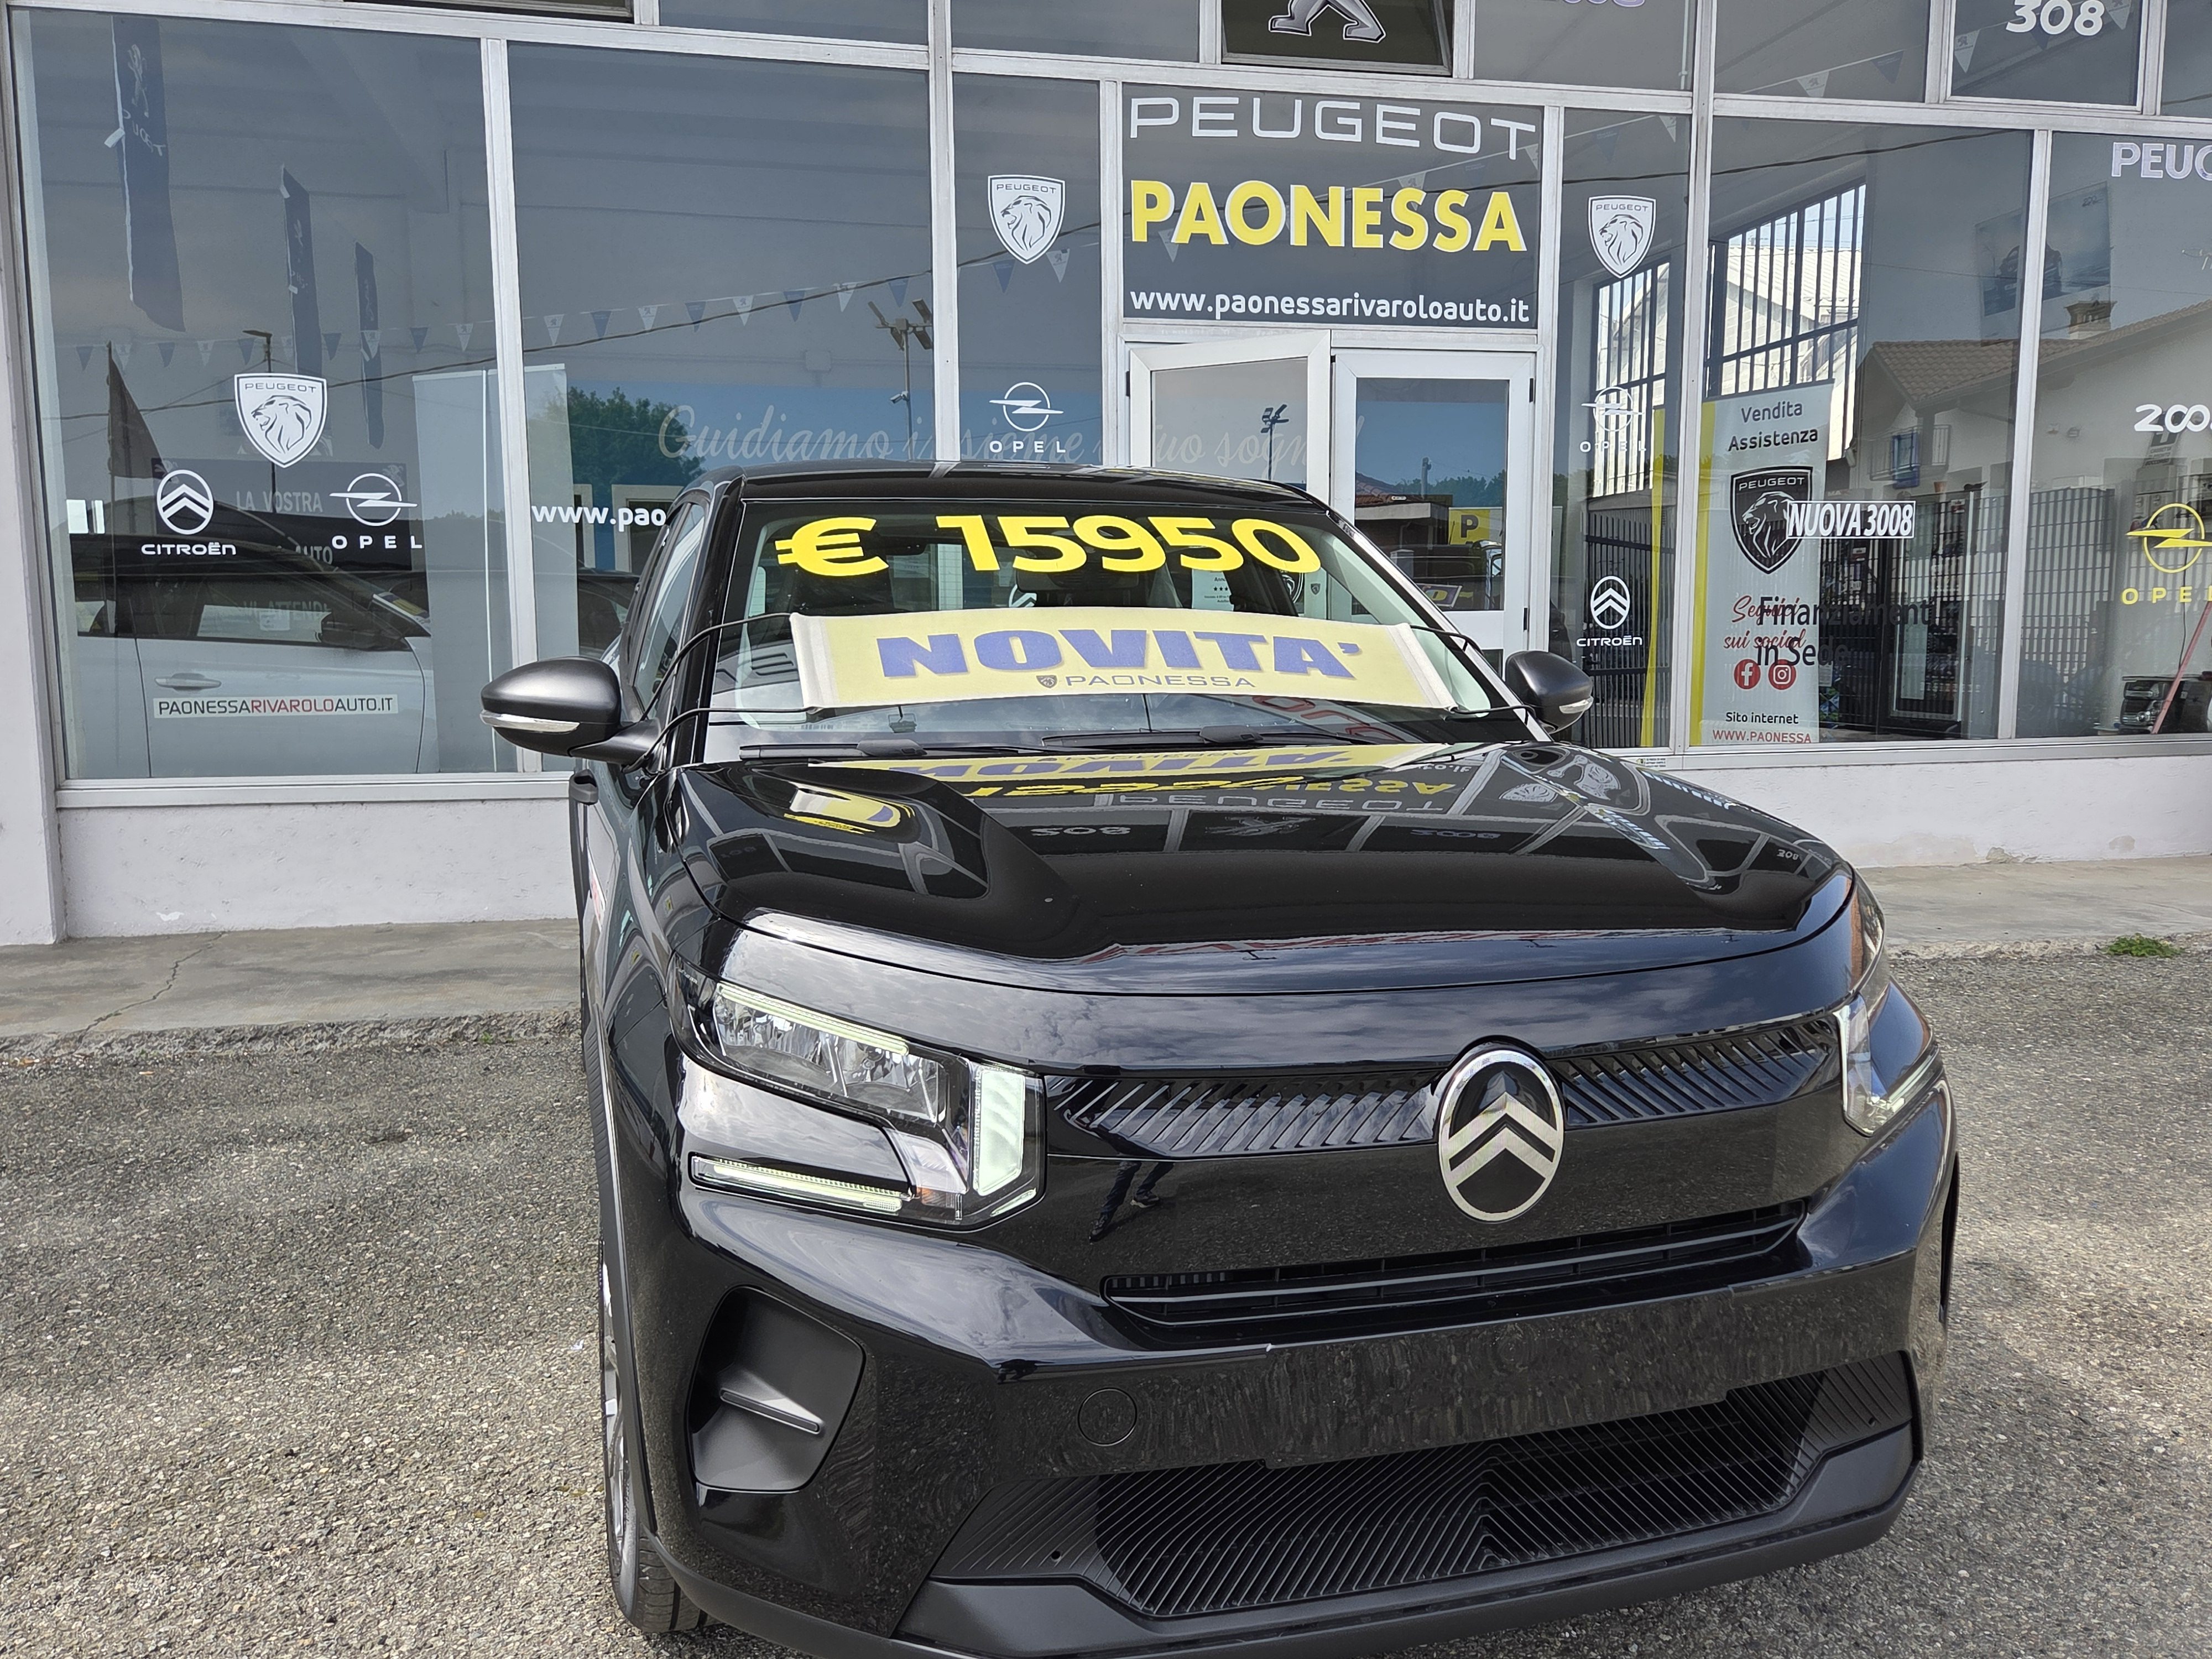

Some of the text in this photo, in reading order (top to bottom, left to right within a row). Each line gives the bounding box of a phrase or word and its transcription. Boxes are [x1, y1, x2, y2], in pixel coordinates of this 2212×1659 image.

[2005, 0, 2105, 36] 308
[1130, 96, 1536, 160] PEUGEOT
[997, 184, 1057, 194] PEUGEOT
[1130, 180, 1528, 253] PAONESSA
[1596, 204, 1648, 212] PEUGEOT
[1130, 291, 1530, 324] www.paonessarivaroloauto.it
[245, 382, 317, 393] PEUGEOT
[1741, 401, 1803, 424] Vendita
[2133, 404, 2212, 434] 200
[989, 440, 1067, 453] OPEL
[1579, 441, 1647, 453] OPEL
[1728, 425, 1818, 452] Assistenza
[1738, 476, 1806, 491] PEUGEOT
[236, 491, 324, 513] LA VOSTRA
[1788, 503, 1914, 537] NUOVA 3008
[331, 535, 422, 550] OPEL
[774, 514, 1322, 577] € 15950
[1723, 630, 1751, 649] sui
[877, 628, 1363, 679] NOVITA'
[1757, 638, 1779, 666] in
[1065, 674, 1256, 688] PAONESSA
[159, 696, 393, 716] PAONESSARIVAROLOAUTO.IT
[1725, 712, 1799, 725] Sito internet
[1712, 730, 1812, 744] WWW.PAONESSA
